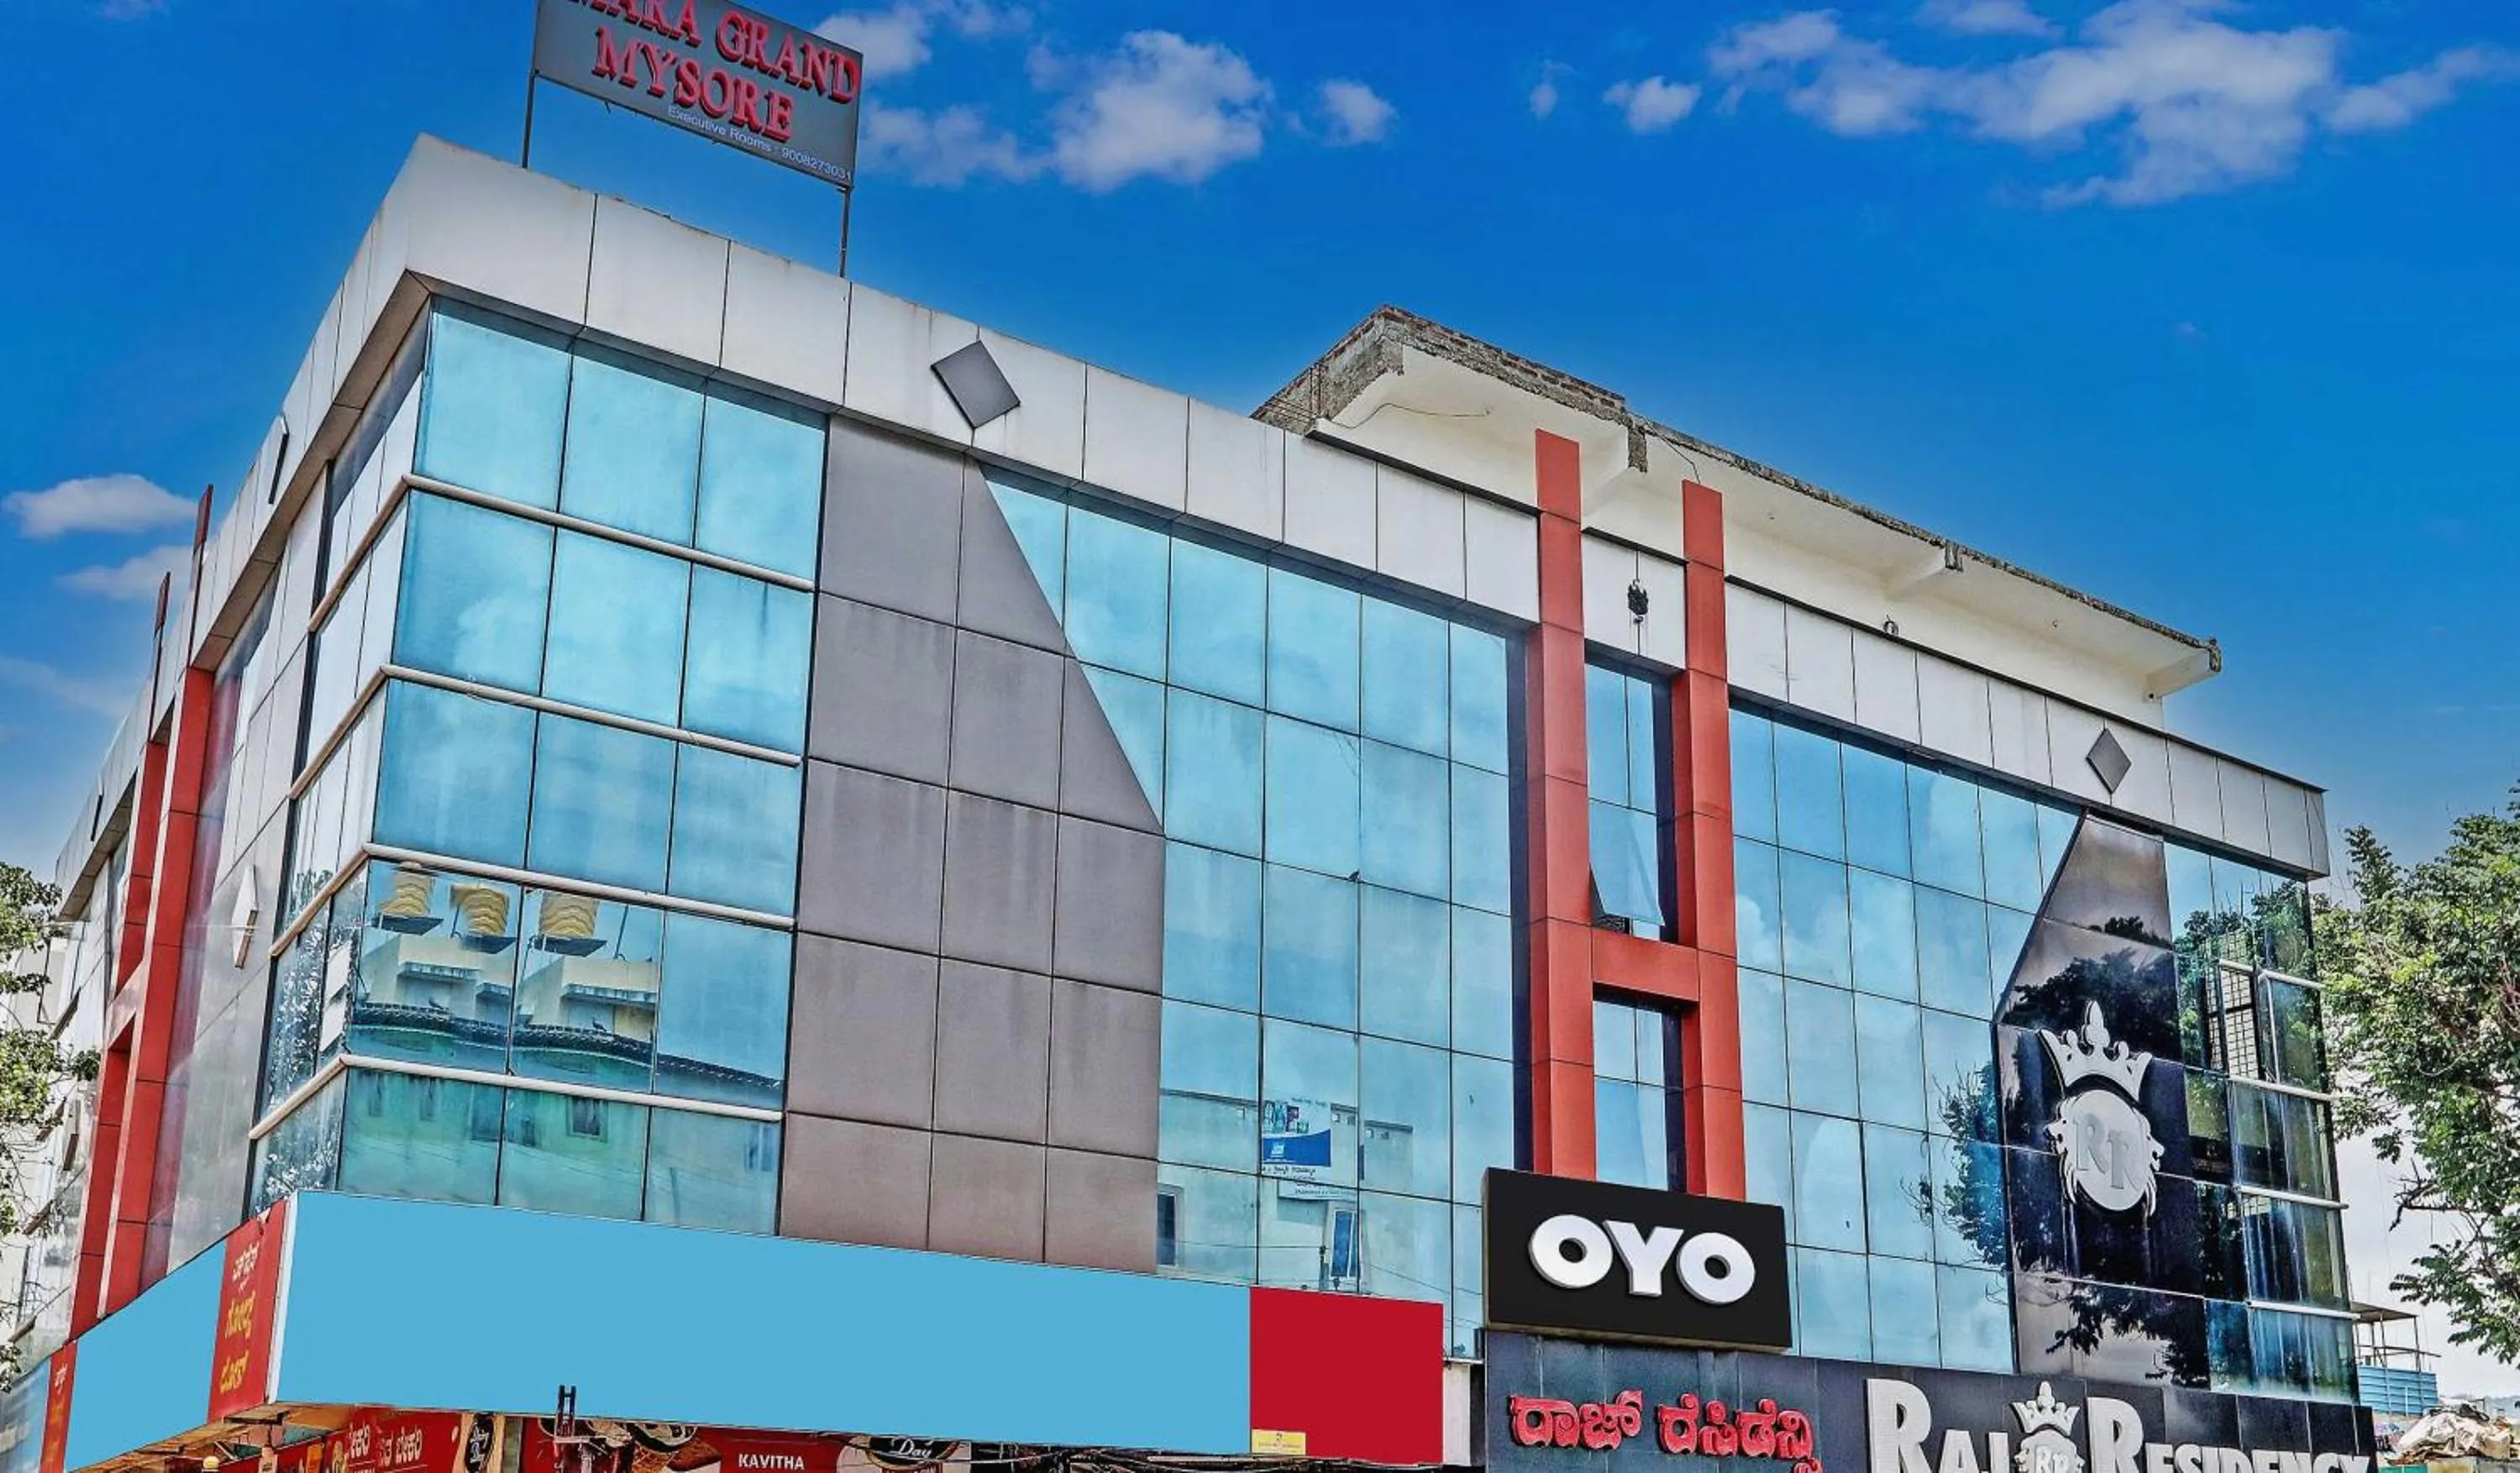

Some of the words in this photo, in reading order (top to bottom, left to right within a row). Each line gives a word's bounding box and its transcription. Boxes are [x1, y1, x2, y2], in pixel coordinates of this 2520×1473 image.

[568, 0, 702, 48] ARA
[715, 10, 859, 104] GRAND
[591, 25, 795, 142] MYSORE
[667, 105, 727, 135] Executive
[729, 128, 773, 153] Rooms
[1528, 1214, 1756, 1305] OYO
[738, 1453, 805, 1470] KAVITHA
[892, 1438, 932, 1459] Day
